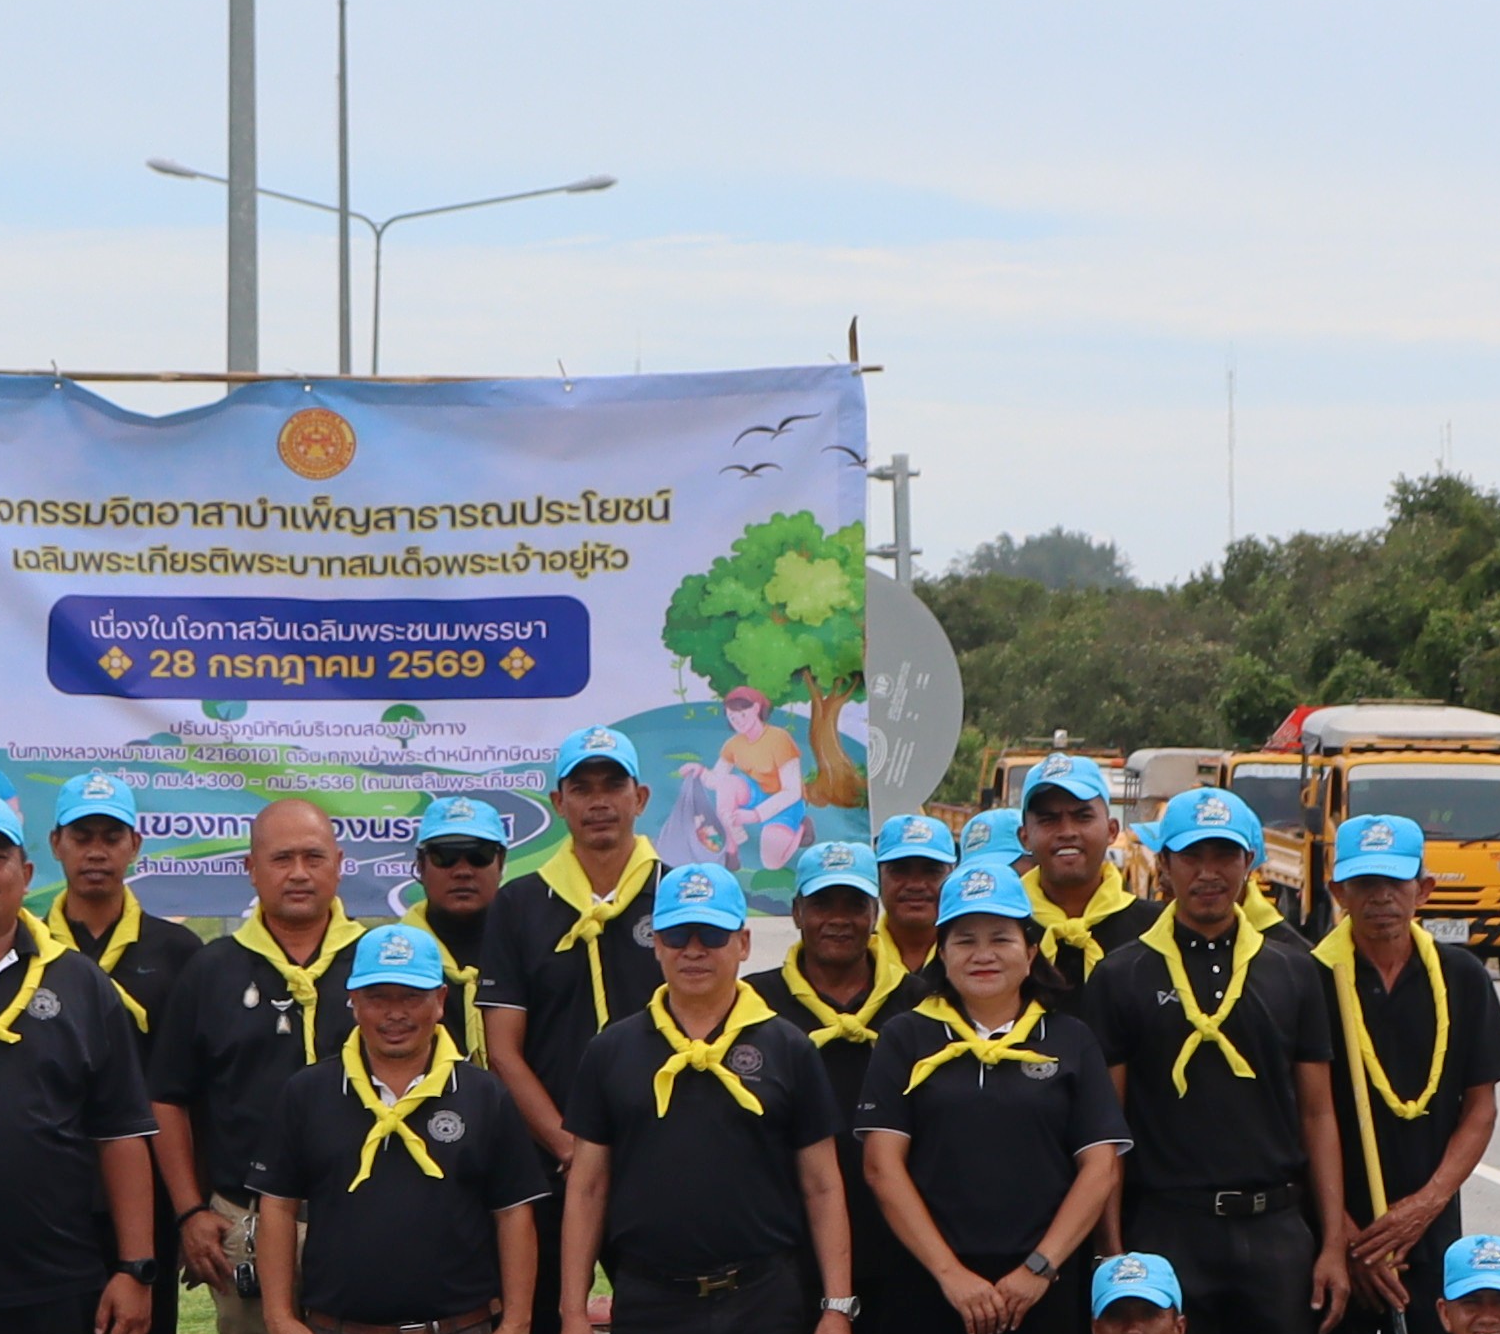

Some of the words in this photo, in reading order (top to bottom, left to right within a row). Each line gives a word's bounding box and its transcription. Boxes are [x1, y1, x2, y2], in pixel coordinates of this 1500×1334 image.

[13, 542, 629, 579] เฉลิมพระเกียรติพระบาทสมเด็จพระเจ้าอยู่หัว
[90, 608, 548, 642] เนื่องในโอกาสวันเฉลิมพระชนมพรรษา
[150, 649, 196, 678] 28
[208, 652, 375, 685] กรกฎาคม
[388, 650, 486, 679] 2569
[169, 718, 466, 743] ปรับปรุงภูมิทัศน์บริเวณสองข้างทาง
[8, 742, 187, 762] ในทางหลวงหมายเลข
[193, 748, 278, 763] 42160101
[328, 743, 560, 763] ทางเข้าพระตำหนักทักษิณรา
[155, 772, 244, 788] กม.4+300
[361, 770, 546, 790] (ถนนเฉลิมพระเกียรติ)
